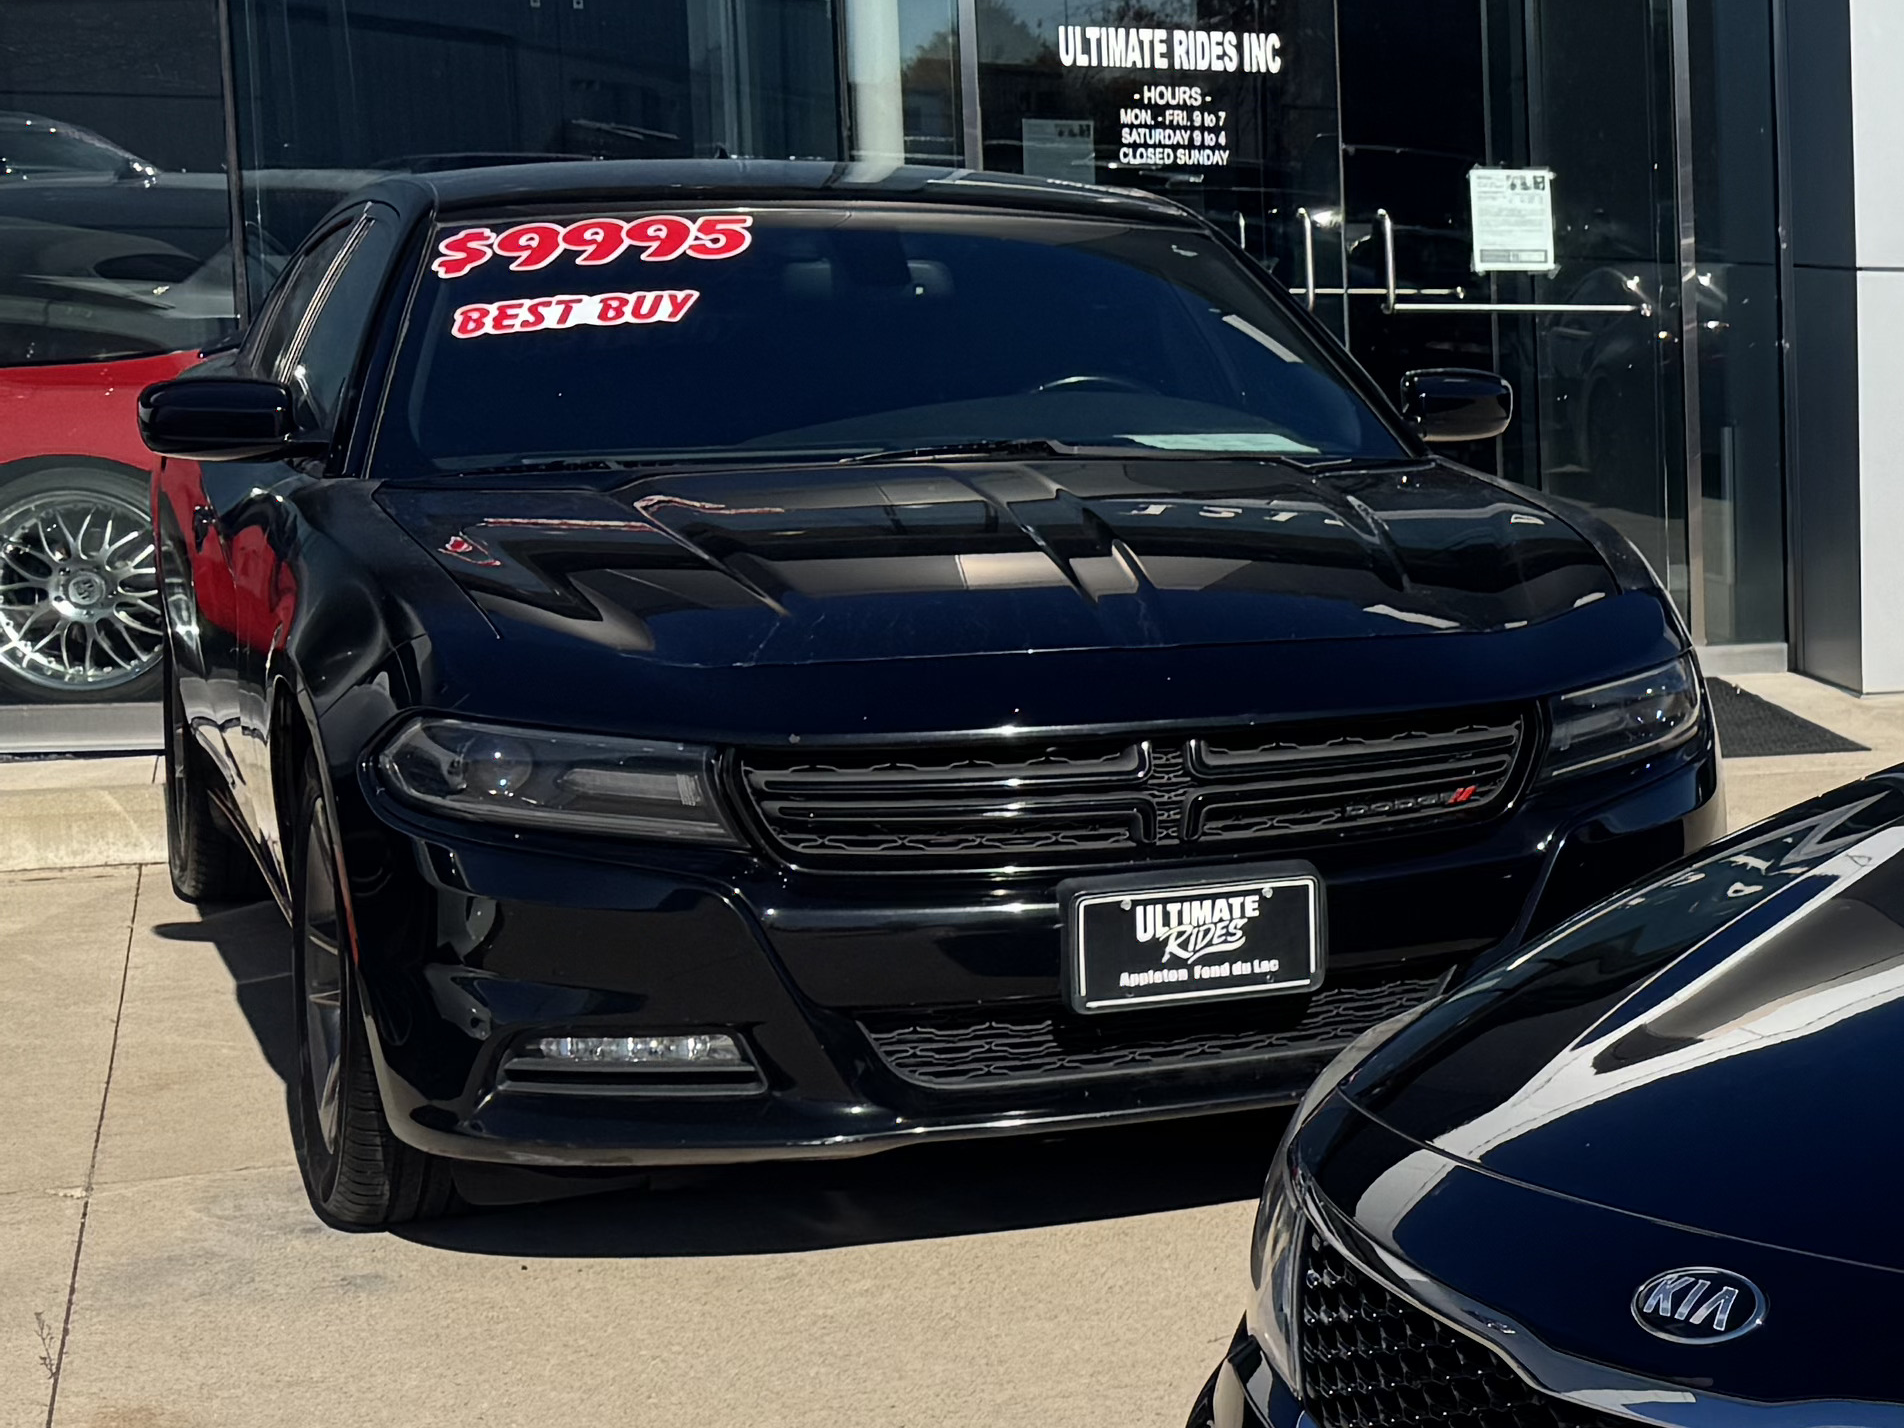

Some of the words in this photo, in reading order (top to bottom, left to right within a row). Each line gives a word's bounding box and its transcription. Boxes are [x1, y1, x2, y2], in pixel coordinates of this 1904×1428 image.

[1058, 25, 1169, 69] ULTIMATE
[1173, 29, 1238, 72] RIDES
[1243, 32, 1282, 73] INC
[1143, 85, 1202, 107] HOURS
[1120, 108, 1154, 125] MON.
[1218, 111, 1226, 127] 7
[1119, 147, 1174, 165] CLOSED
[1176, 149, 1230, 166] SUNDAY
[1121, 128, 1190, 146] SATURDAY
[1218, 131, 1226, 147] 4
[431, 214, 753, 279] $9995
[451, 295, 586, 339] BEST
[594, 289, 700, 326] BUY
[1135, 895, 1260, 943] ULTIMATE
[1119, 967, 1189, 987] Appleton
[1194, 961, 1231, 980] Fond
[1231, 960, 1252, 976] du
[1253, 959, 1280, 974] Lac
[1643, 1276, 1739, 1331] KIA
